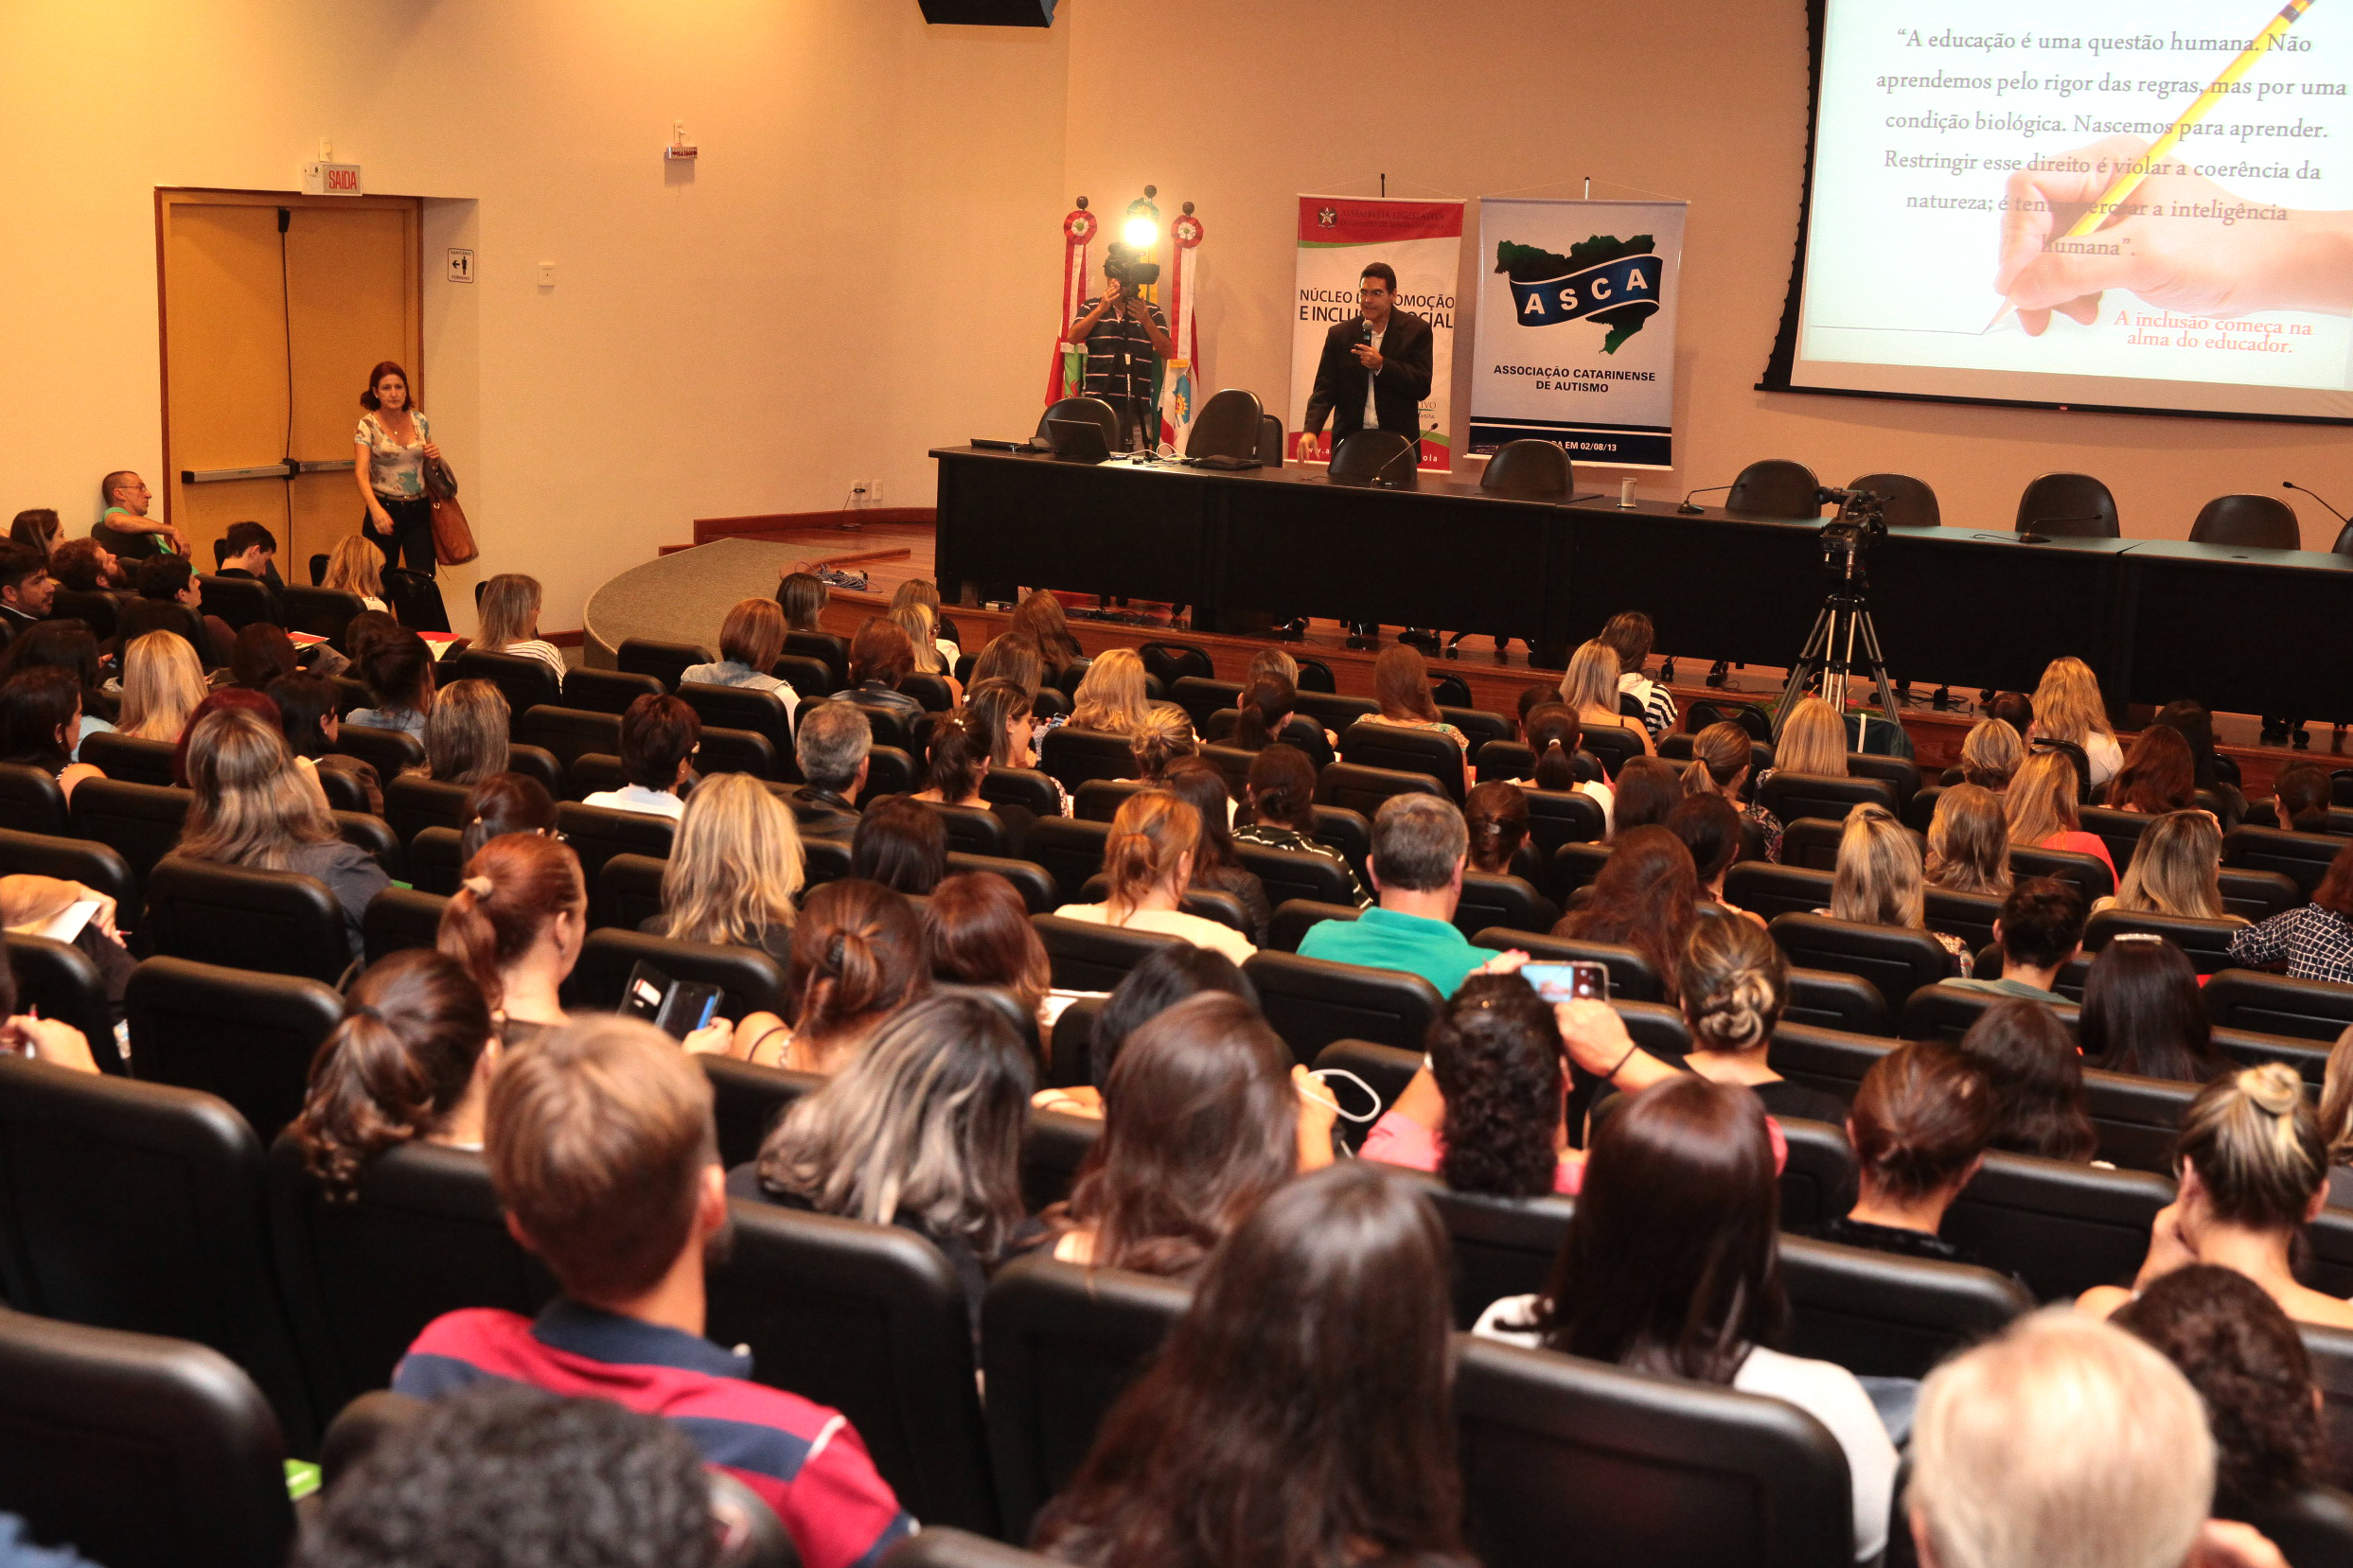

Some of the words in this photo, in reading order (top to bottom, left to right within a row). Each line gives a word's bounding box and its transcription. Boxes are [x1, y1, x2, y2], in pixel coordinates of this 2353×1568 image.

[1898, 28, 1921, 46] “A
[1928, 28, 2015, 53] educação
[2022, 32, 2031, 48] é
[2039, 37, 2081, 49] uma
[2088, 35, 2164, 57] questão
[2170, 31, 2259, 51] humana.
[2266, 34, 2311, 51] Não
[1876, 69, 1991, 94] aprendemos
[1996, 71, 2038, 97] pelo
[2044, 75, 2094, 97] rigor
[2098, 72, 2132, 92] das
[2137, 80, 2204, 99] regras,
[2210, 81, 2251, 94] mas
[2256, 82, 2294, 101] por
[2301, 84, 2346, 96] uma
[1885, 110, 1969, 133] condição
[1975, 111, 2066, 137] biológica.
[2073, 115, 2173, 134] Nascemos
[2178, 123, 2224, 142] para
[2230, 118, 2327, 143] aprender.
[1884, 150, 1977, 176] Restringir
[1983, 158, 2022, 170] esse
[2027, 153, 2090, 173] direito
[2096, 158, 2107, 173] é
[2114, 156, 2170, 175] violar
[2176, 165, 2186, 175] a
[2194, 162, 2290, 178] coerência
[2296, 160, 2321, 180] da
[1906, 195, 1991, 213] natureza;
[1998, 196, 2008, 211] é
[2153, 204, 2163, 216] a
[2170, 200, 2288, 225] inteligência
[1300, 287, 1353, 304] NÚCLEO
[1393, 293, 1455, 311] OMOÇÃO
[1300, 305, 1309, 321] E
[2113, 310, 2128, 326] A
[2135, 310, 2208, 330] inclusão
[2215, 319, 2282, 334] começa
[2289, 324, 2312, 336] na
[2127, 328, 2169, 346] alma
[2177, 330, 2199, 348] do
[2205, 331, 2293, 353] educador.
[1494, 365, 1570, 379] ASSOCIAÇÃO
[1573, 369, 1655, 381] CATARINENSE
[1536, 380, 1550, 390] DE
[1554, 381, 1609, 393] AUTISMO
[1581, 443, 1617, 451] 02/08/13
